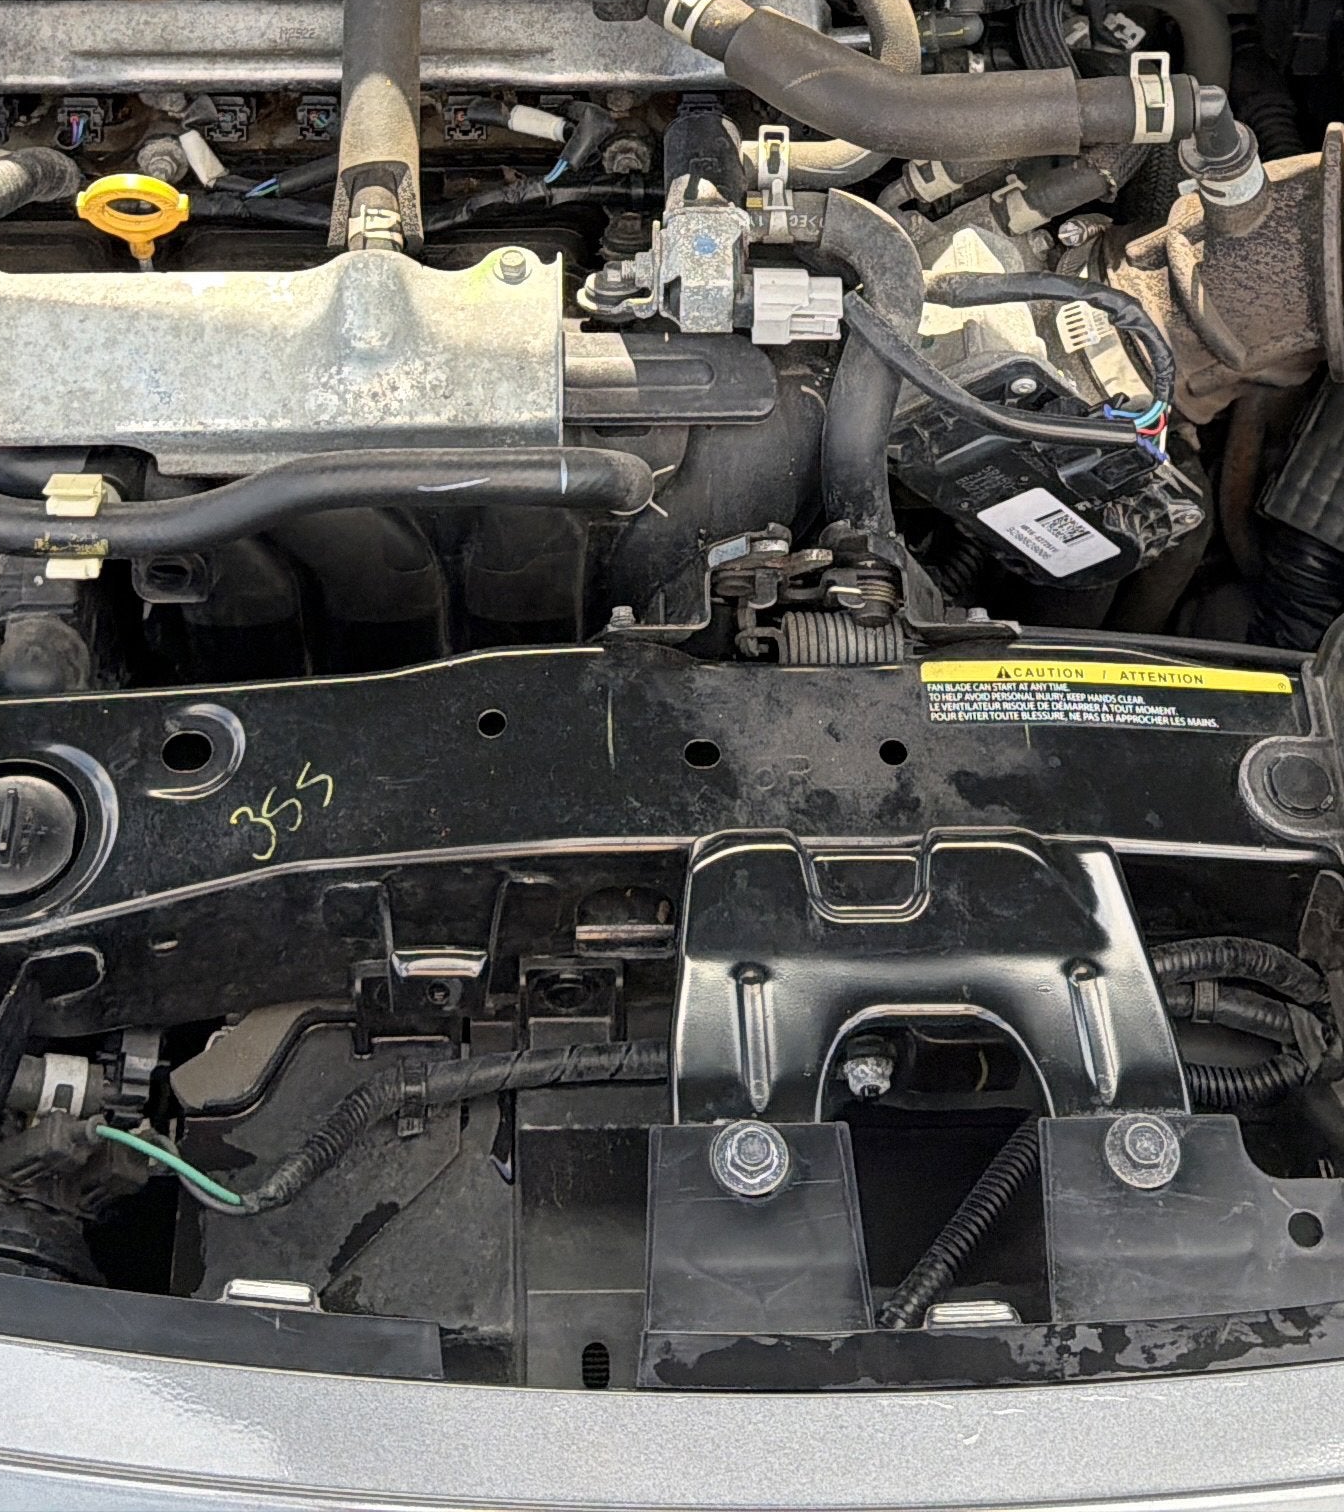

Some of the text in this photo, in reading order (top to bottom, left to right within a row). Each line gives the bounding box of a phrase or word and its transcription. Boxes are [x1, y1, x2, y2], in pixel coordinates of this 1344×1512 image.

[1013, 667, 1084, 679] CAUTION
[1120, 671, 1204, 685] ATTENTION
[927, 682, 944, 692] FAN
[945, 682, 972, 692] BLADE
[973, 682, 991, 691] CAN
[992, 682, 1018, 691] START
[1019, 682, 1029, 691] AT
[1030, 682, 1049, 691] ANY
[929, 692, 941, 701] TO
[942, 692, 963, 701] HELP
[964, 692, 990, 701] AVOID
[991, 692, 1034, 701] PERSONAL
[1067, 692, 1087, 702] KEEP
[1088, 693, 1117, 703] HANDS
[929, 702, 940, 712] LE
[940, 701, 1002, 711] VENTILATEUR
[1002, 701, 1036, 712] RISQUE
[1036, 702, 1051, 711] DE
[1051, 700, 1100, 712] DÉMARRER
[1108, 704, 1134, 714] TOUT
[930, 712, 957, 721] POUR
[957, 711, 989, 721] ÉVITER
[989, 711, 1020, 721] TOUTE
[1021, 711, 1068, 722] BLESSURE,
[1068, 712, 1083, 722] NE
[1083, 712, 1100, 723] PAS
[1100, 713, 1114, 723] EN
[1115, 714, 1170, 726] APPROCHER
[1170, 716, 1186, 726] LES
